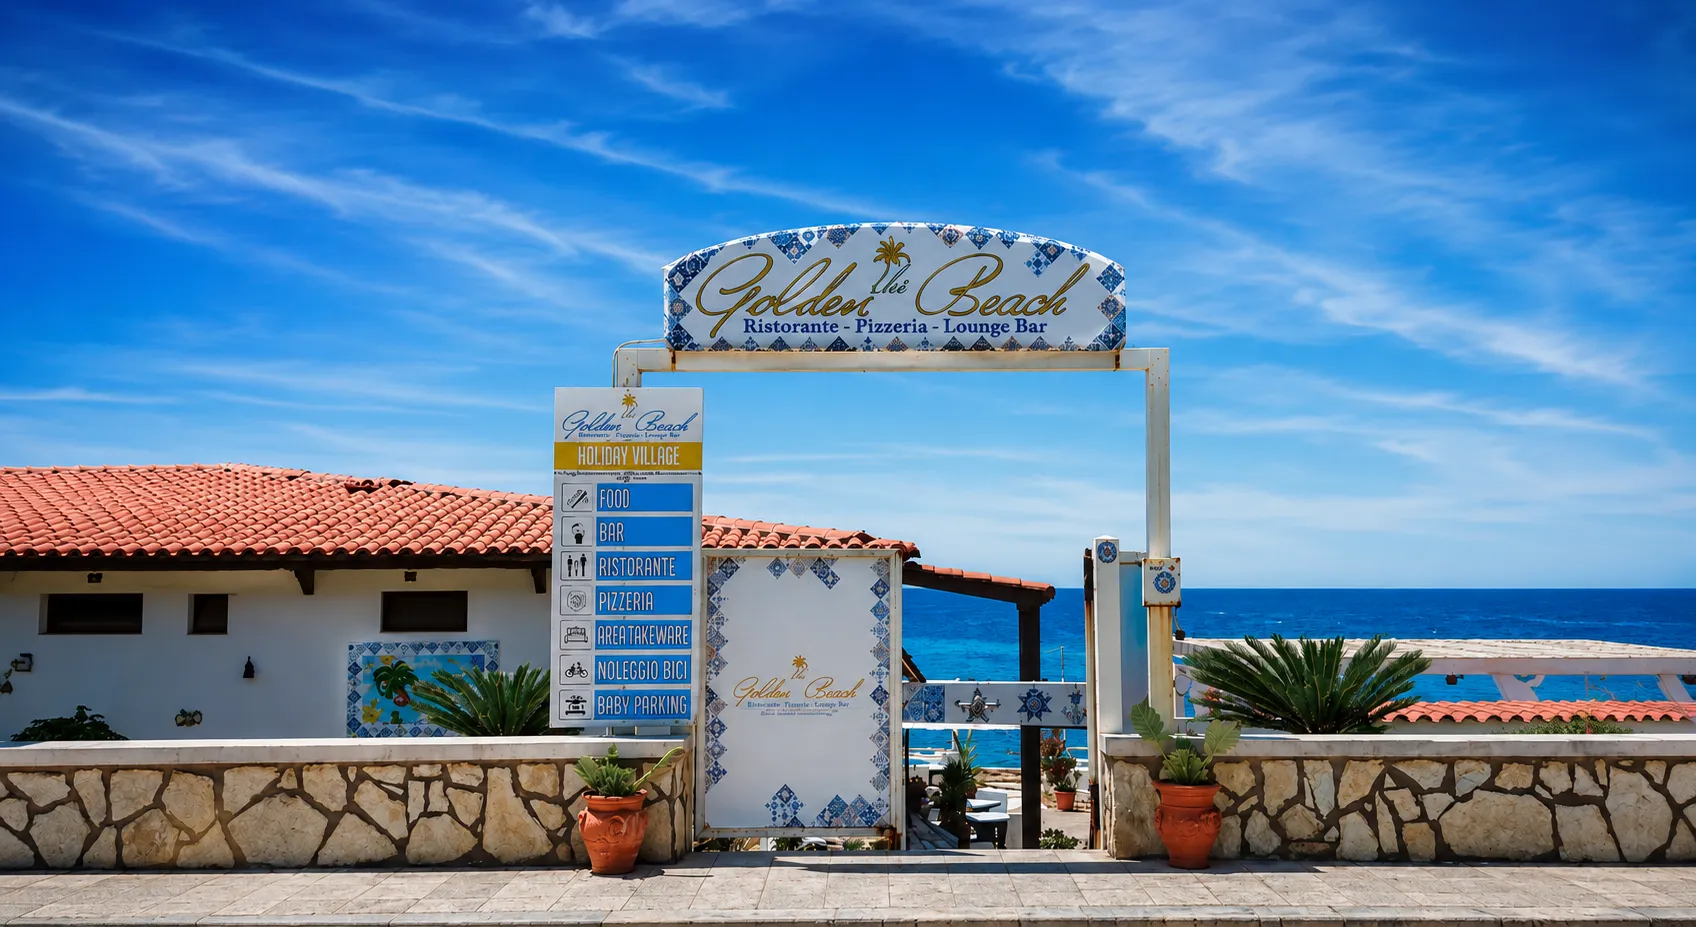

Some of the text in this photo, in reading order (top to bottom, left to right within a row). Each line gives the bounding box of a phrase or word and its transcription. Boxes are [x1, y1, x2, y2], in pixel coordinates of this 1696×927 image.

[695, 252, 1090, 338] Golden Beach
[743, 318, 839, 334] Ristorante
[855, 318, 928, 333] Pizzeria
[943, 318, 1010, 338] Lounge
[1014, 318, 1048, 333] Bar
[635, 410, 699, 432] Beach
[578, 446, 680, 466] HOLIDAY VILLAGE
[599, 489, 630, 509] FOOD
[599, 522, 625, 542] BAR
[599, 557, 676, 577] RISTORANTE
[599, 592, 654, 611] PIZZERIA
[598, 625, 689, 645] AREA TAKEWARE
[598, 660, 687, 680] NOLEGGIO BICI
[733, 676, 865, 707] Golden Beach
[598, 695, 688, 715] BABY PARKING
